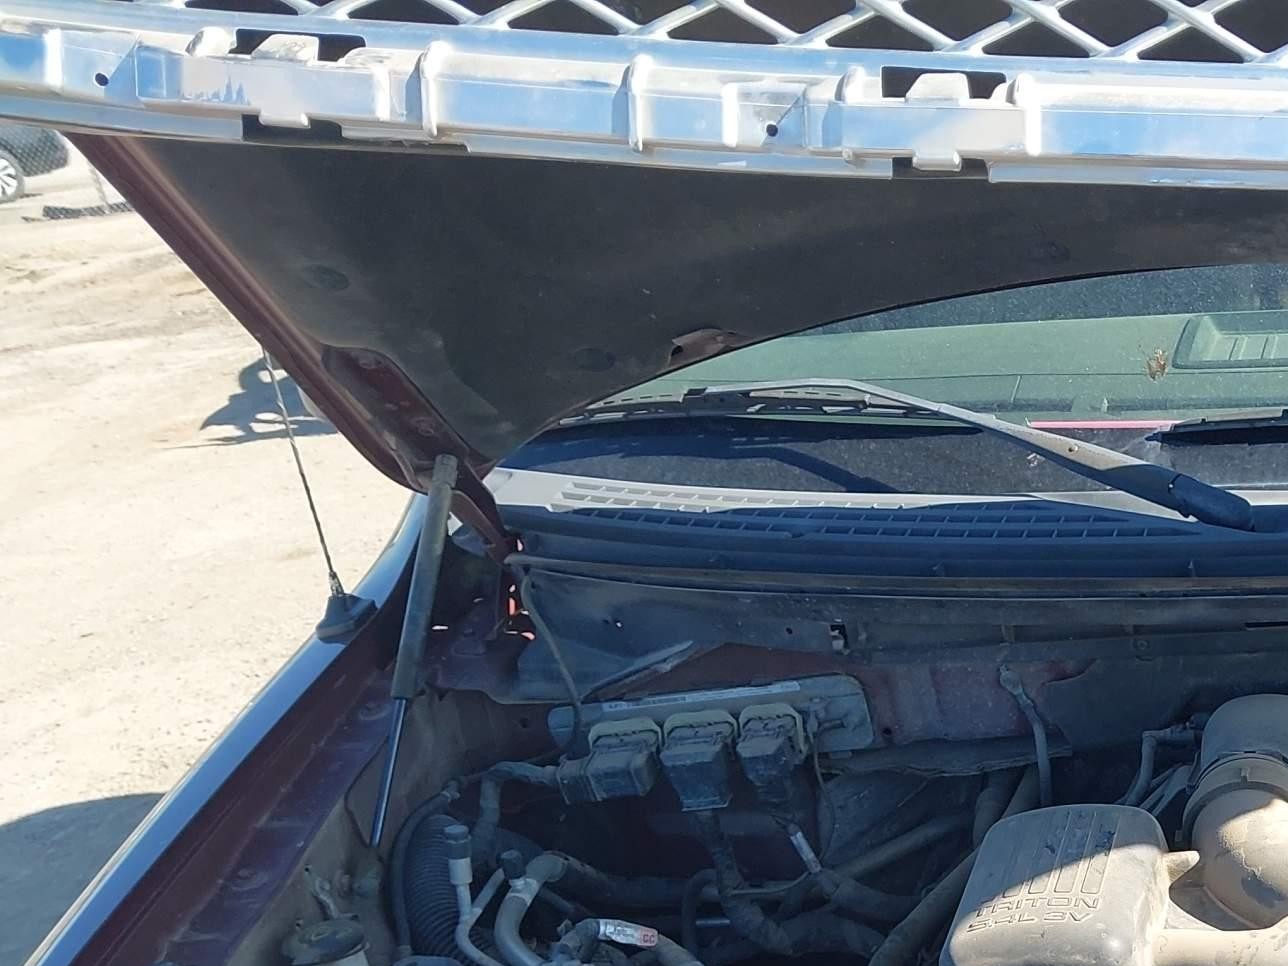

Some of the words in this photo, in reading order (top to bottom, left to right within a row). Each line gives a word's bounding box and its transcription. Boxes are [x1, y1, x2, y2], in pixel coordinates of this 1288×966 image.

[976, 897, 1100, 917] TRITON
[966, 913, 1036, 933] 5.4L
[1043, 911, 1092, 922] 3V
